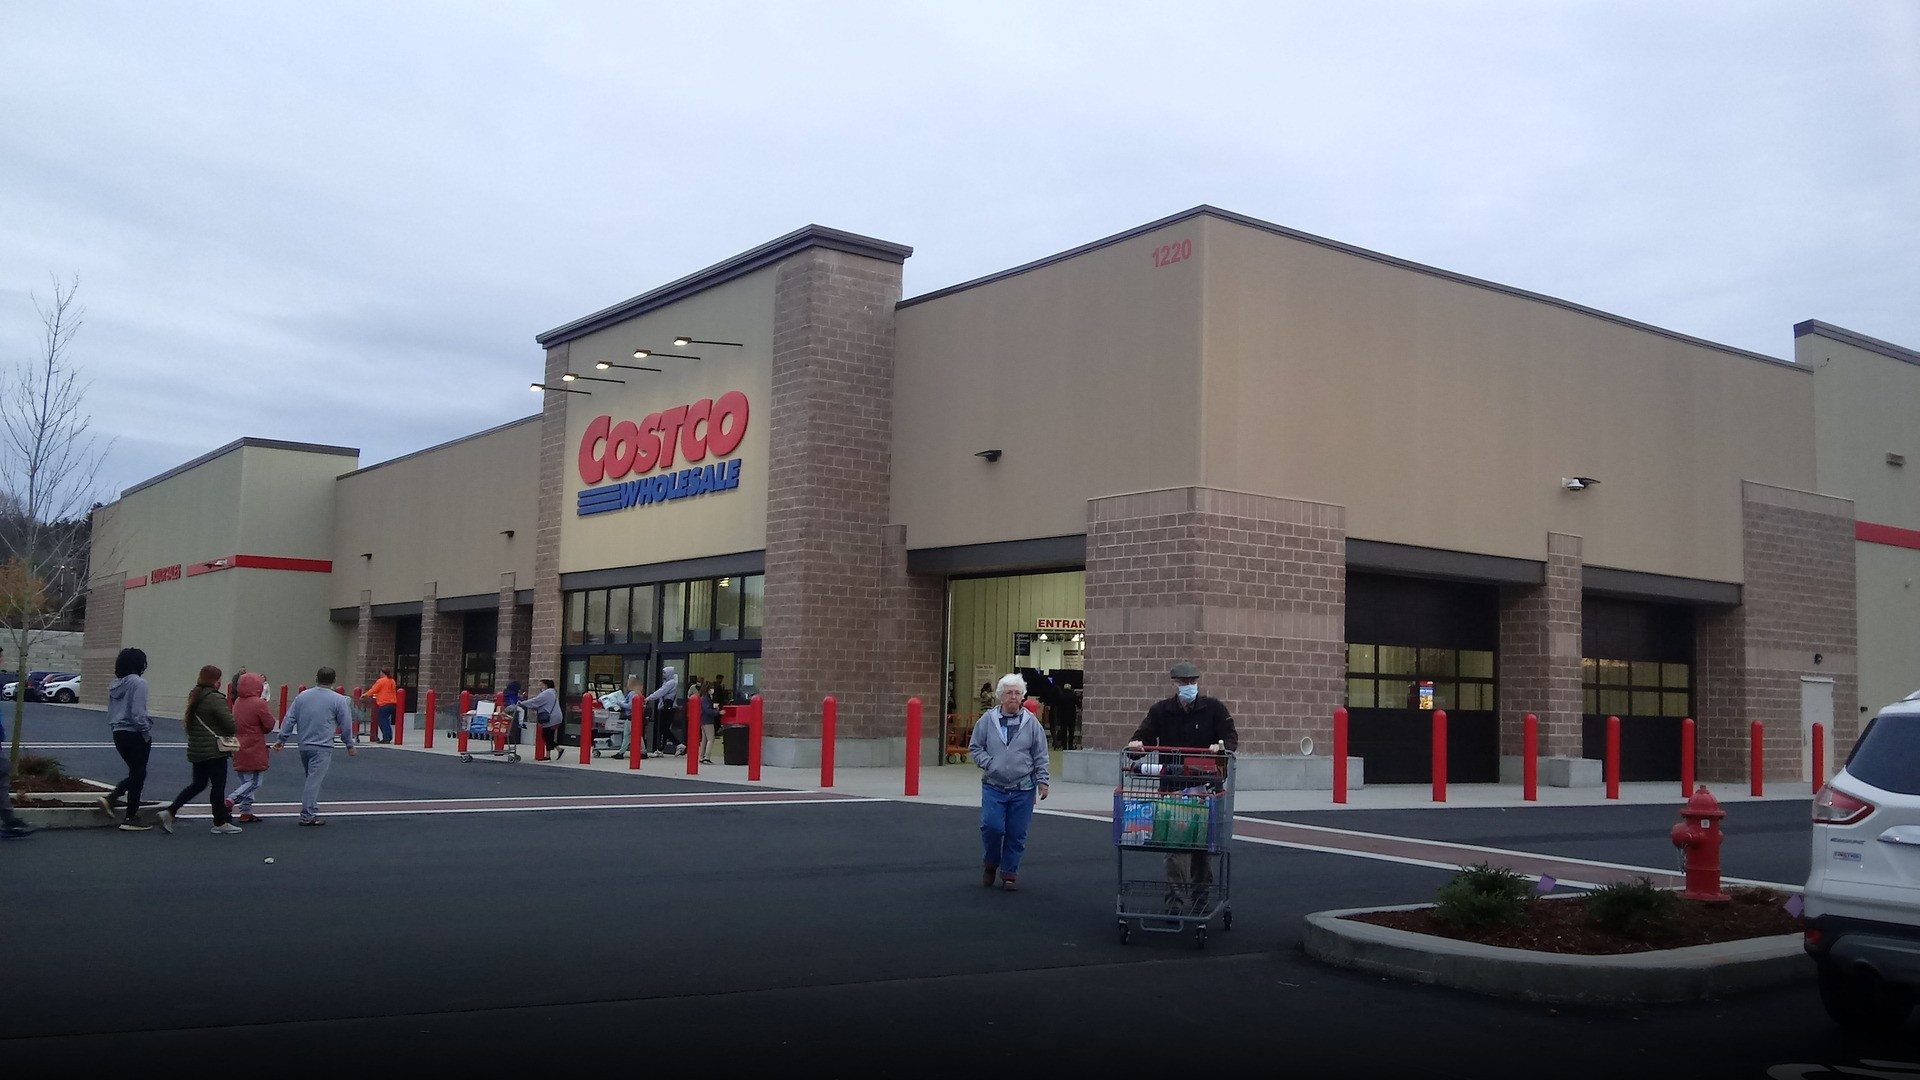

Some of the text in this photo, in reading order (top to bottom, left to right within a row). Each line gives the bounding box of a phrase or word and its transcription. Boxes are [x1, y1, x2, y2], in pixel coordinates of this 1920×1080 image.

[1152, 239, 1192, 267] 1220
[578, 390, 749, 484] COSTCO
[620, 458, 742, 509] WHOLESALE
